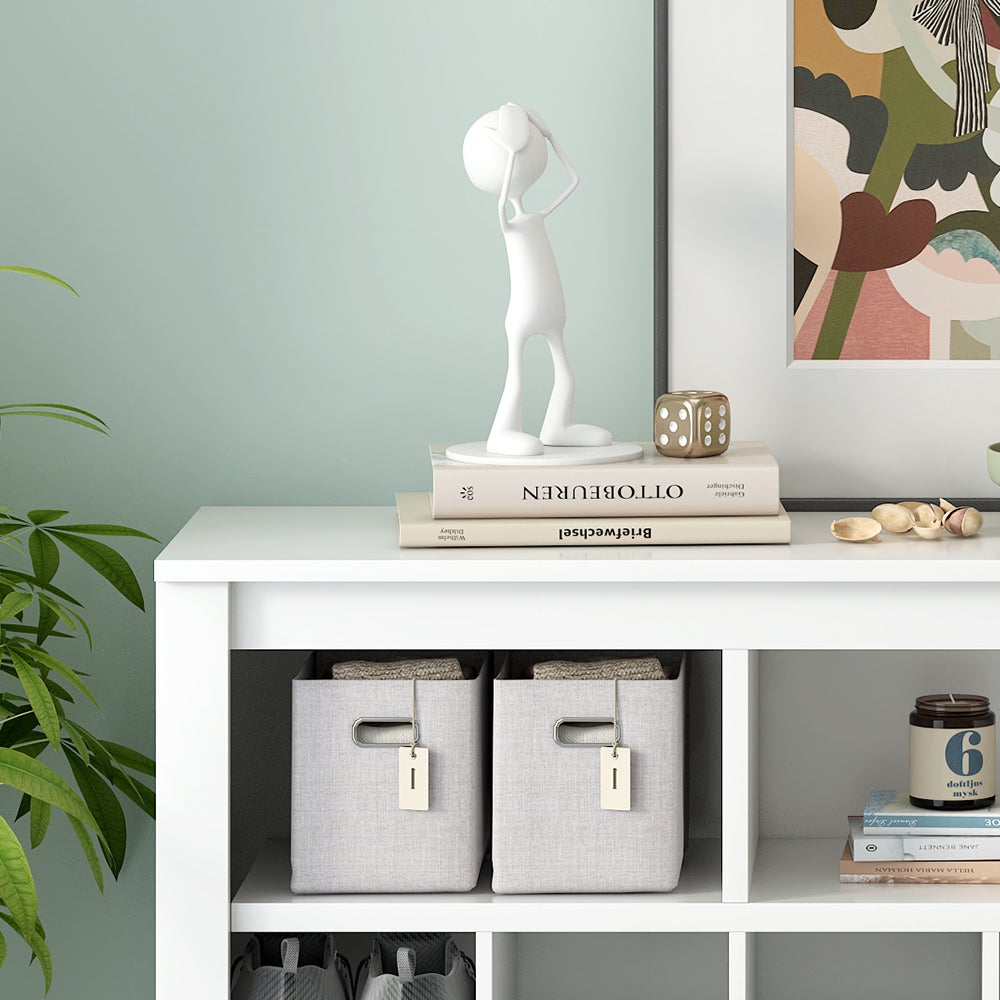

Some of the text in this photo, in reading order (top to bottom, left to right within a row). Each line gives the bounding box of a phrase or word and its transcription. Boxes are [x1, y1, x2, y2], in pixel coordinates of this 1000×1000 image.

[522, 484, 684, 500] OTTOBEUREN
[558, 527, 652, 540] Briefwechsel
[945, 730, 984, 777] 6
[946, 780, 983, 788] doftljus
[953, 789, 978, 799] mysk
